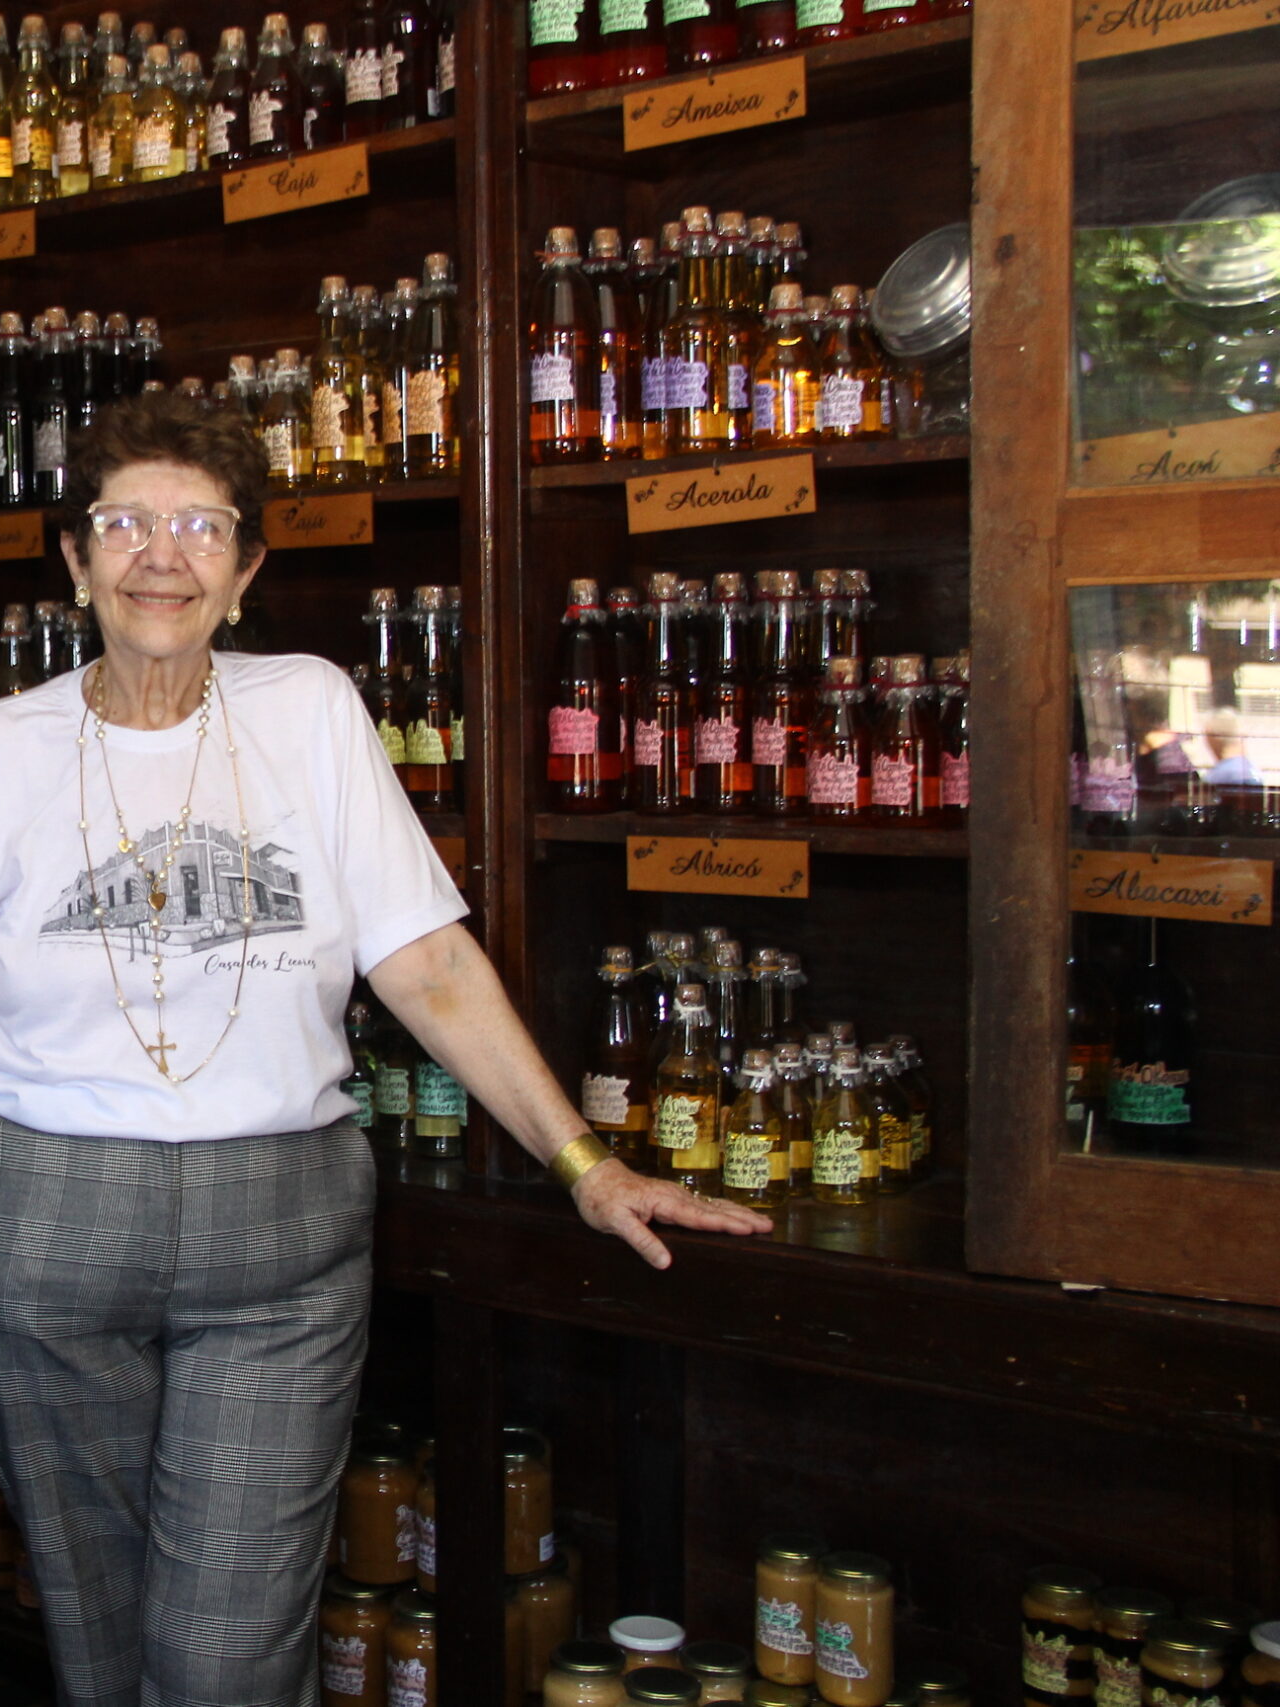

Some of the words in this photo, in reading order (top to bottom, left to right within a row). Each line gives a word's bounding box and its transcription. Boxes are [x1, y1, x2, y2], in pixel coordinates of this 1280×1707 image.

[662, 93, 765, 128] Ameixa
[268, 168, 319, 198] Cajá
[666, 473, 773, 511] Acerola
[670, 849, 765, 879] Abricó
[1085, 869, 1224, 906] Abacaxi
[204, 954, 242, 975] Casa
[246, 953, 269, 970] dos
